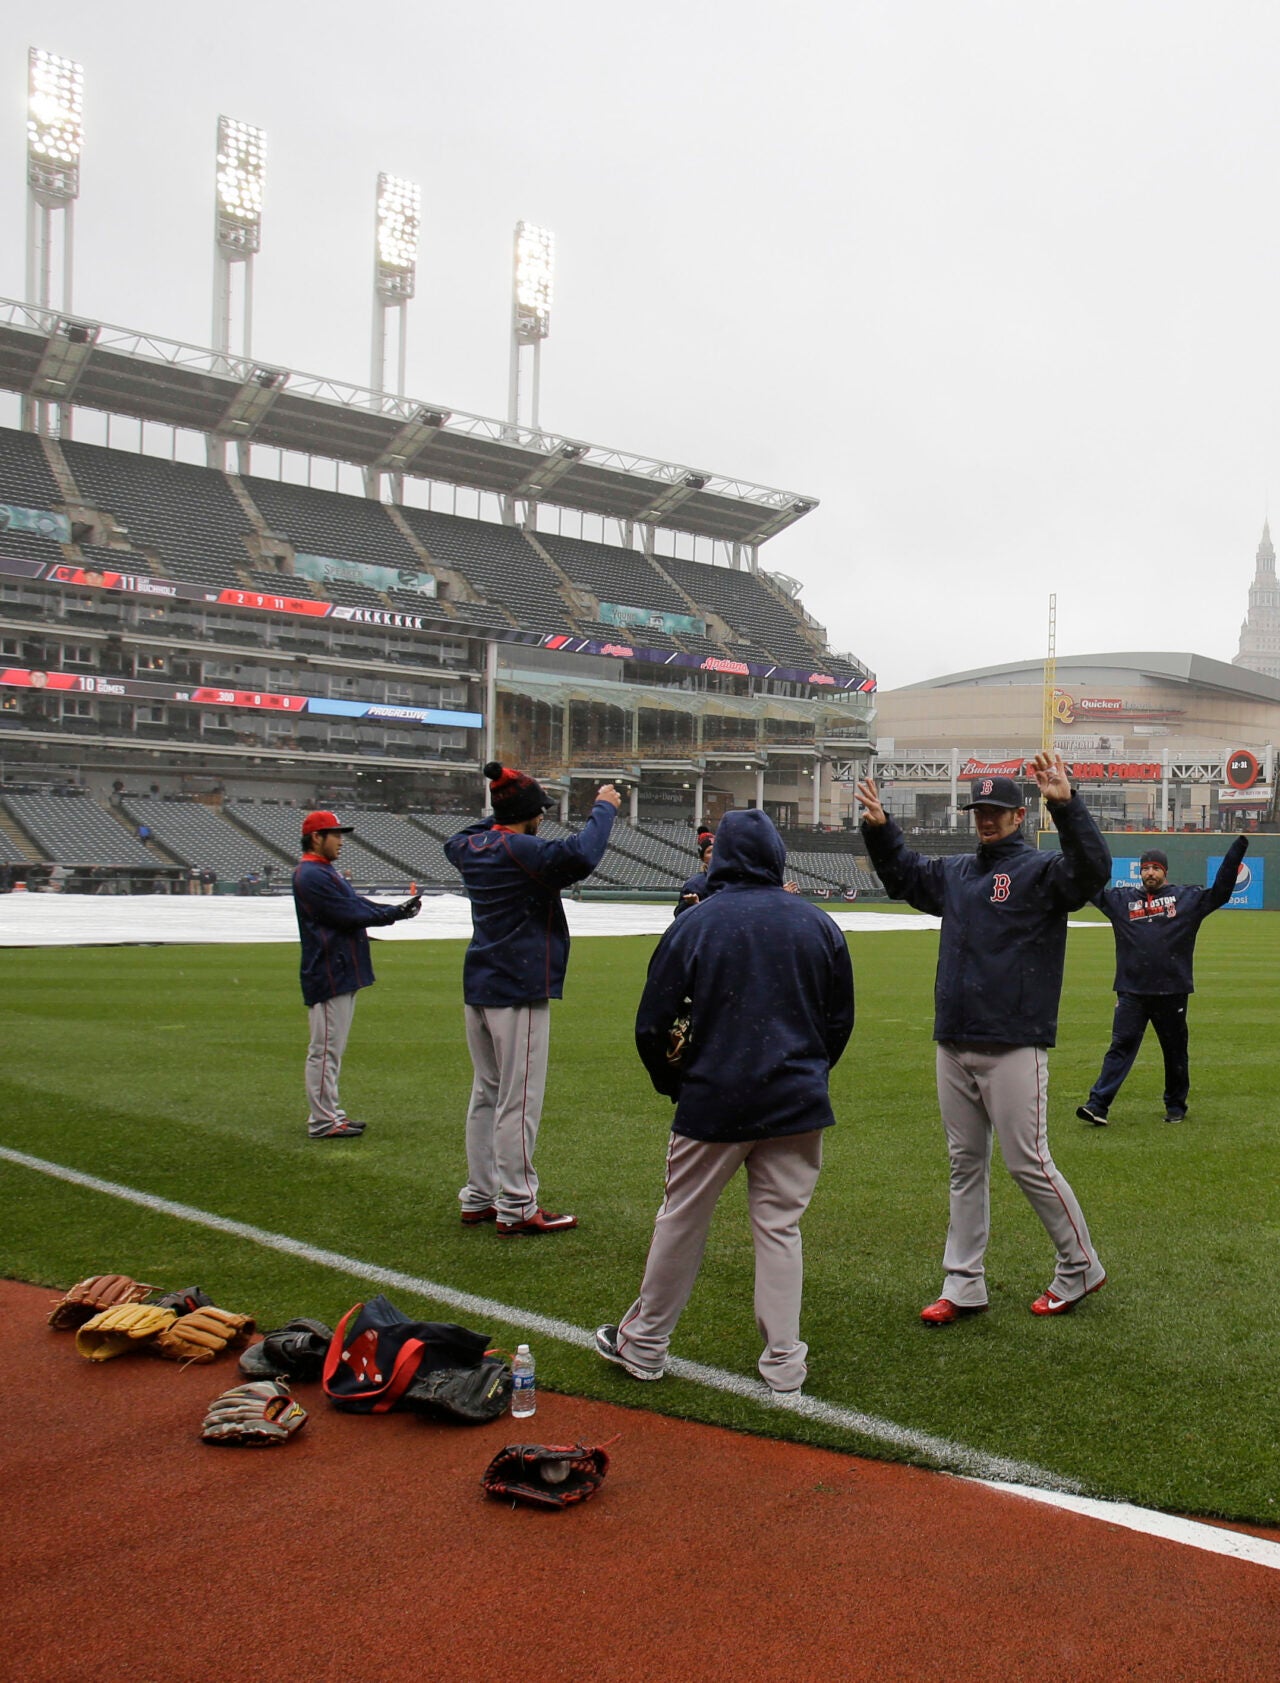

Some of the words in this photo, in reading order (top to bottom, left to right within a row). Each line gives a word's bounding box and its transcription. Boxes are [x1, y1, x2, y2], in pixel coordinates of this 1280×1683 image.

[120, 575, 135, 591] 11
[137, 582, 177, 597] BUCHHOLZ
[237, 593, 244, 604] 2
[256, 596, 264, 606] 9
[275, 599, 284, 609] 11
[701, 656, 750, 676] Indians
[78, 676, 94, 692] 10
[97, 684, 126, 695] GOMES
[215, 691, 235, 703] .300
[254, 694, 261, 705] 0
[283, 697, 290, 708] 0
[1081, 699, 1121, 710] Quicken
[366, 705, 429, 721] PROGRESSIVE
[962, 762, 1019, 777] Budweiser
[1072, 763, 1105, 779] RUN
[1107, 763, 1162, 780] PORCH
[979, 779, 994, 796] B
[990, 873, 1012, 903] B
[1227, 894, 1249, 905] epsi
